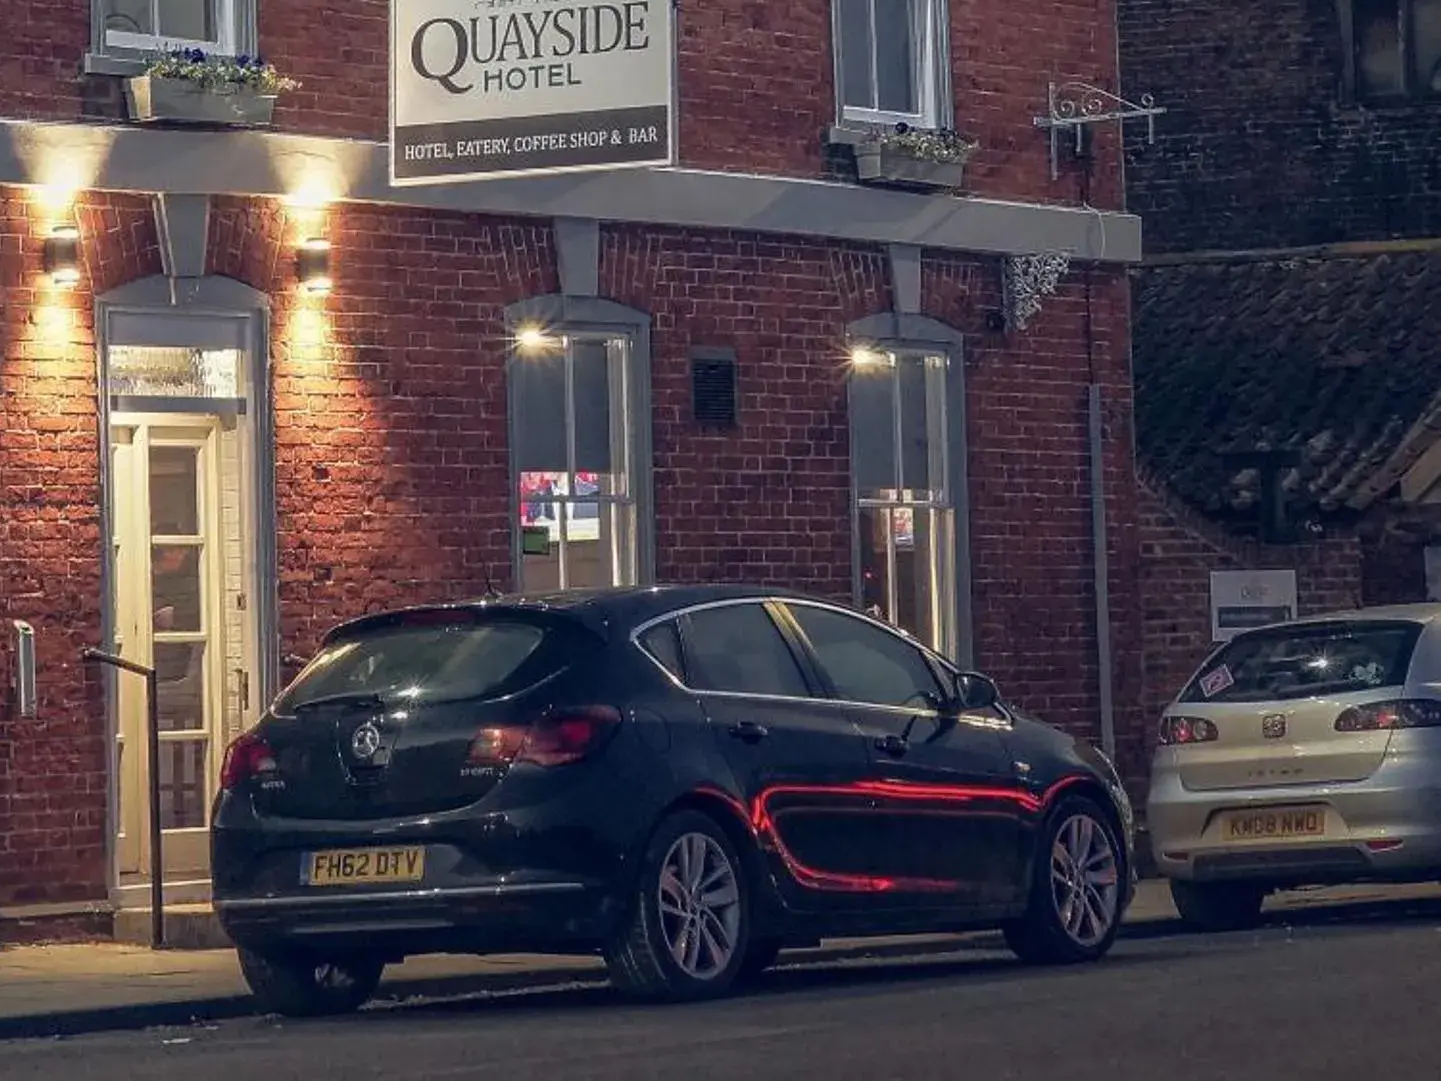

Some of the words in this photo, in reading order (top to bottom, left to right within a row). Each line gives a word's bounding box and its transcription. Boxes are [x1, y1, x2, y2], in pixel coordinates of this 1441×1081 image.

[411, 1, 649, 94] QUAYSIDE
[484, 64, 582, 92] HOTEL
[405, 143, 454, 160] HOTEL,
[457, 137, 511, 157] EATERY,
[514, 133, 567, 152] COFFEE
[569, 131, 608, 149] SHOP
[610, 129, 622, 145] &
[628, 126, 658, 144] BAR
[315, 853, 369, 879] FH62
[375, 849, 419, 877] DTV
